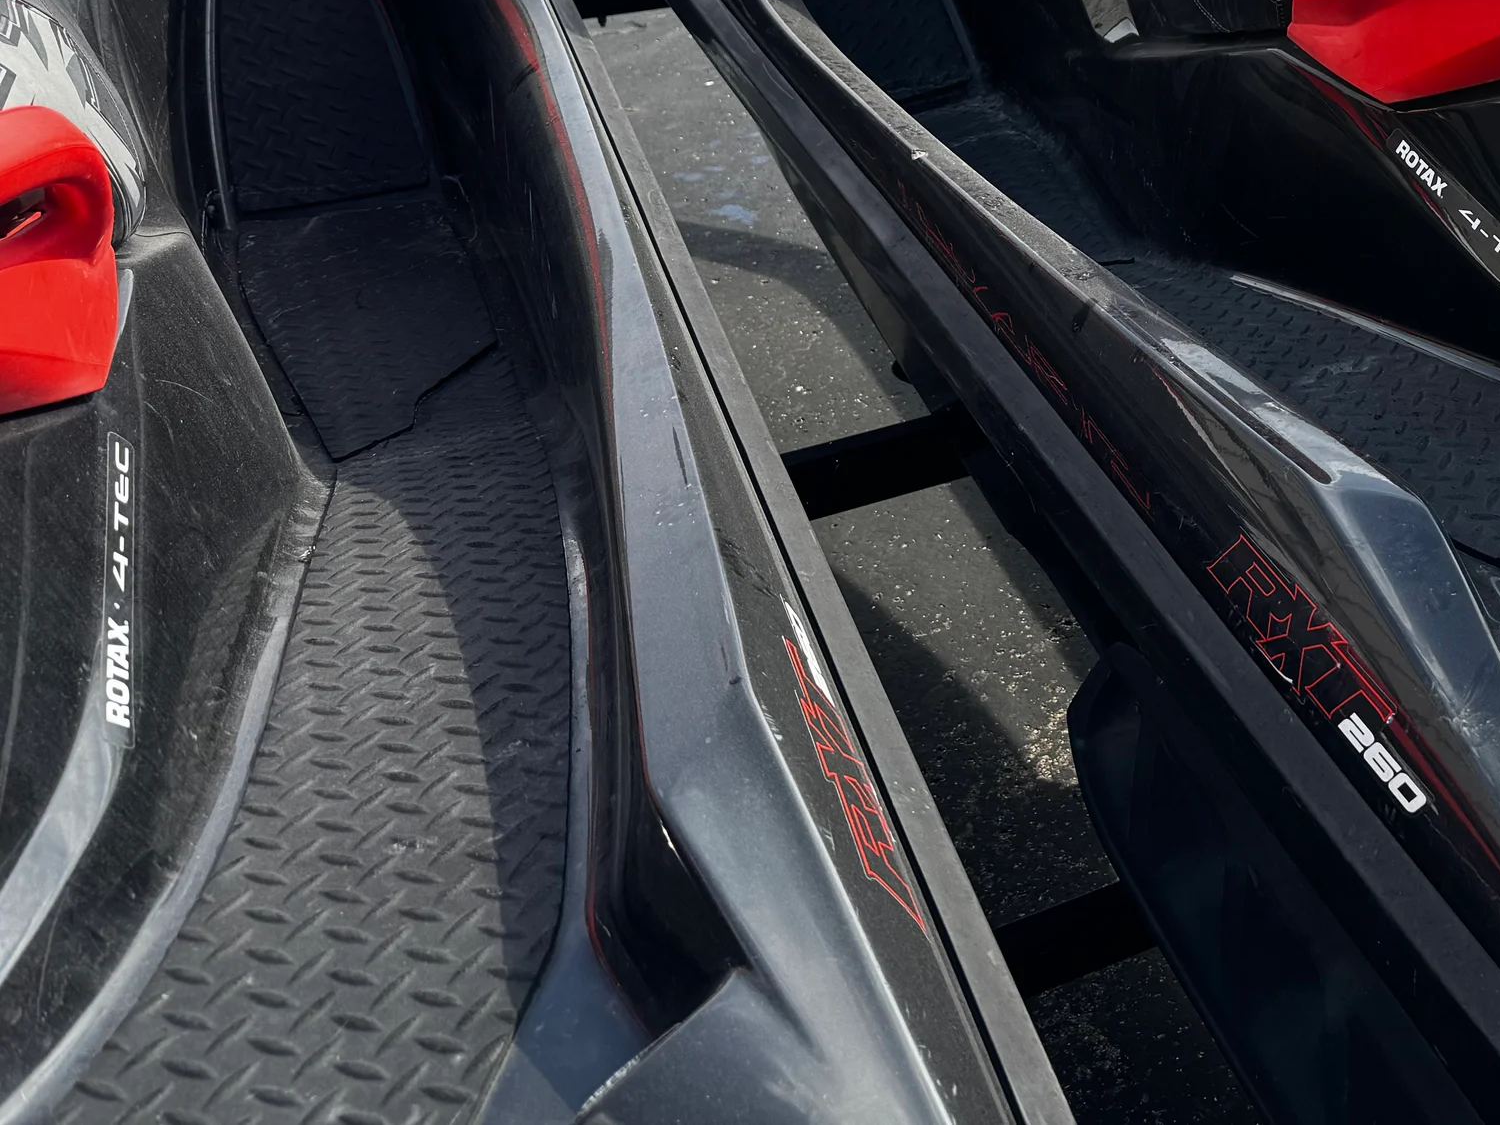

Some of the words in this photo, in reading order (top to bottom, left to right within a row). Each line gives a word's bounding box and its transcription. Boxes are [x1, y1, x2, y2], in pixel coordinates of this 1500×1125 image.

[1395, 139, 1448, 198] ROTAX
[111, 441, 131, 593] 4-TEC
[105, 617, 131, 729] ROTAX
[1206, 534, 1396, 720] RXT
[1337, 712, 1427, 814] 260
